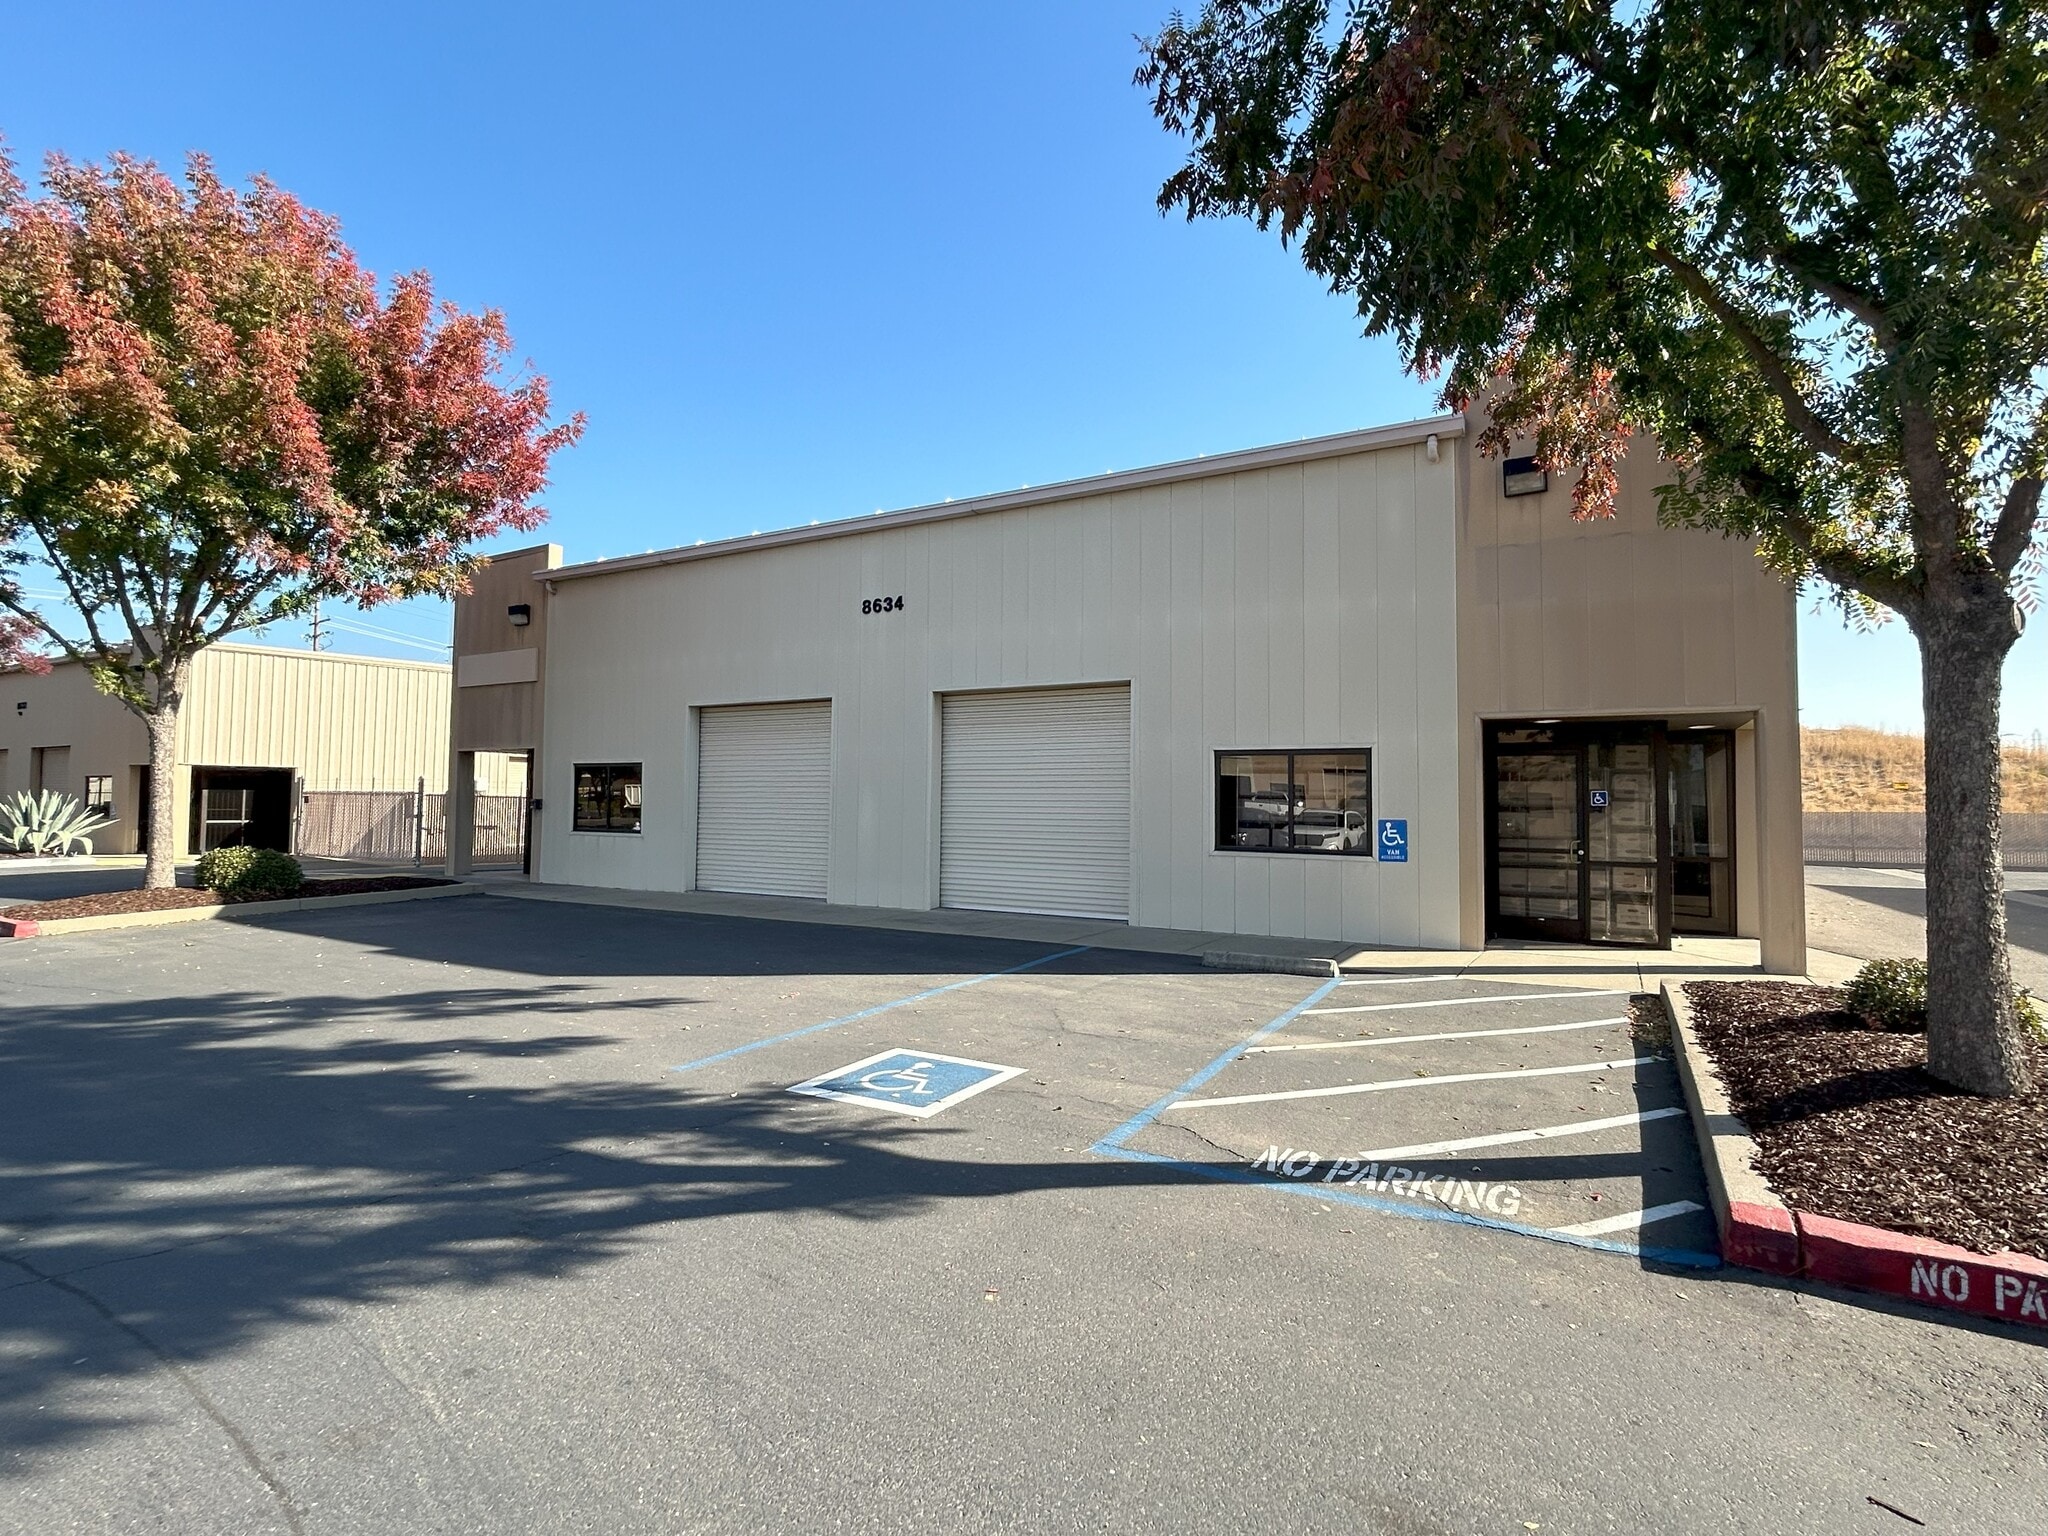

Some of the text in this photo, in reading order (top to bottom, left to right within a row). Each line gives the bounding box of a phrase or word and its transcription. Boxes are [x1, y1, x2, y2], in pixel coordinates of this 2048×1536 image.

[862, 595, 904, 614] 8634
[1251, 1145, 1521, 1215] NO PARKING
[1911, 1258, 1969, 1302] NO
